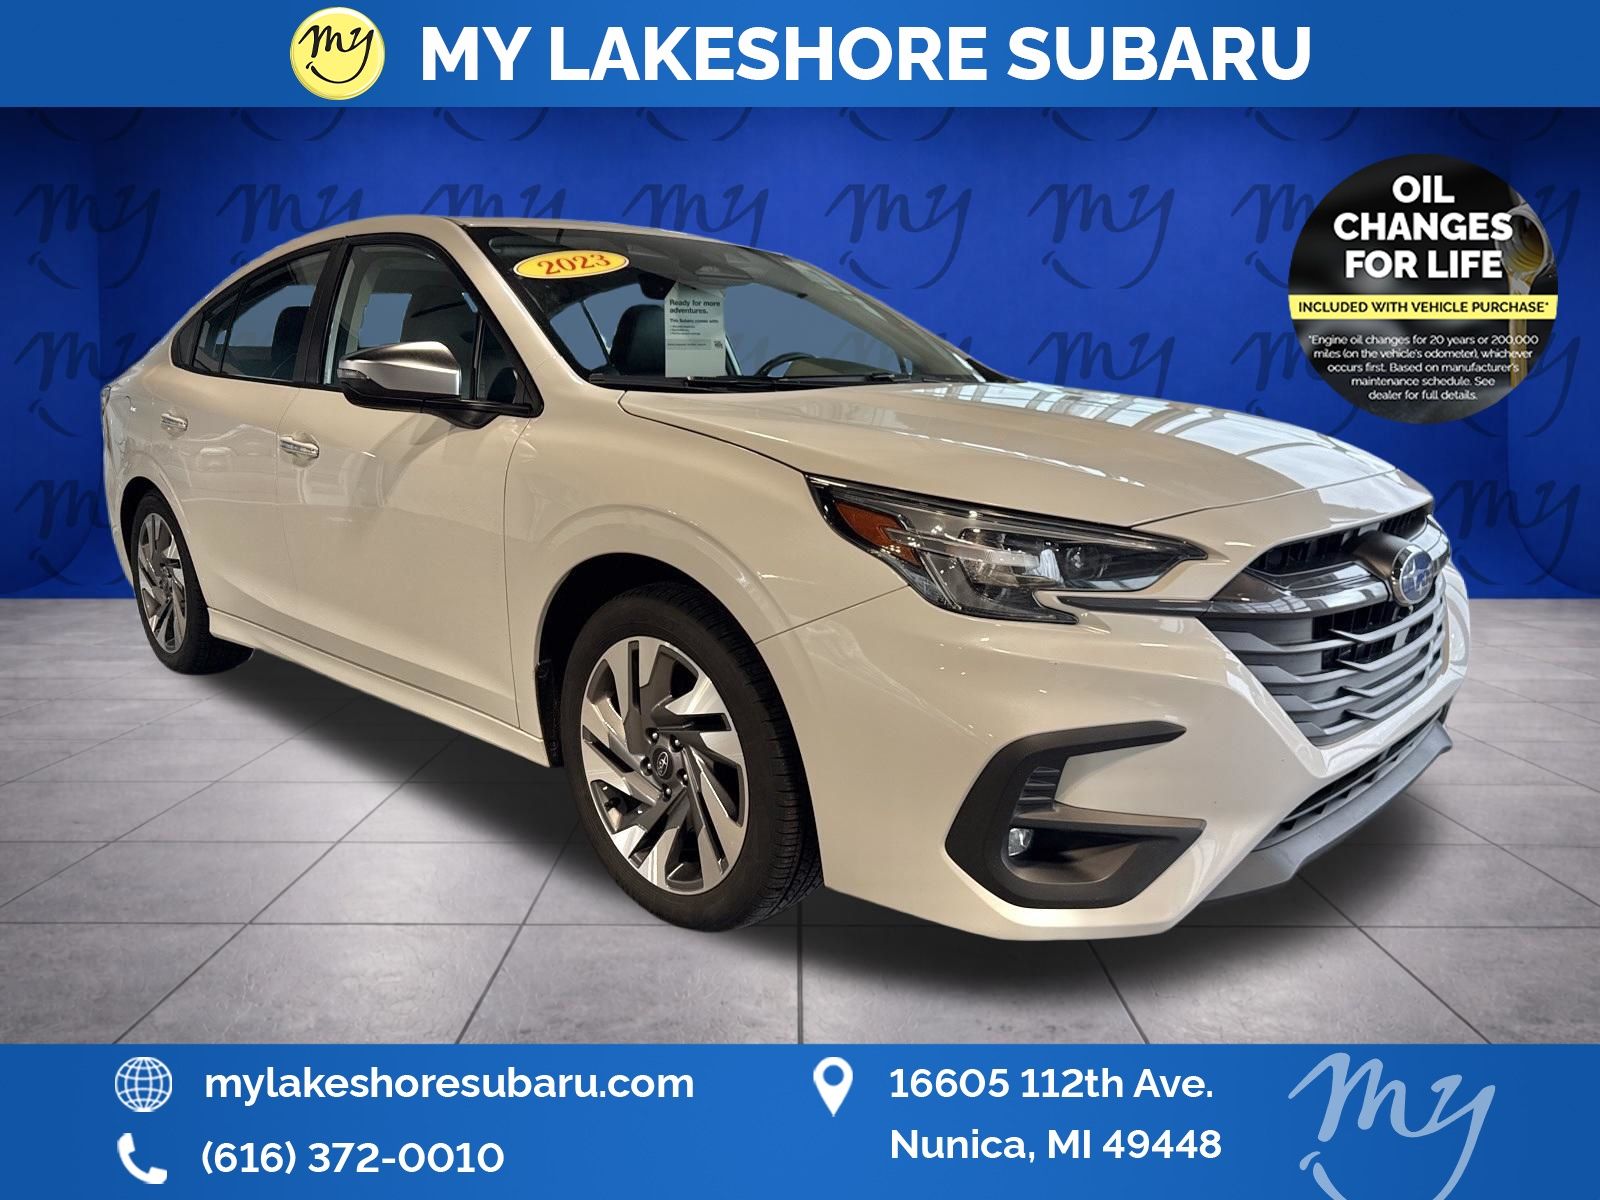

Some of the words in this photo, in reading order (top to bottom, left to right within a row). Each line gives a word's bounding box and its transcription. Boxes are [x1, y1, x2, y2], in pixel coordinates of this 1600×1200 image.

[537, 254, 611, 275] 2023
[669, 299, 690, 307] Ready
[692, 299, 701, 307] for
